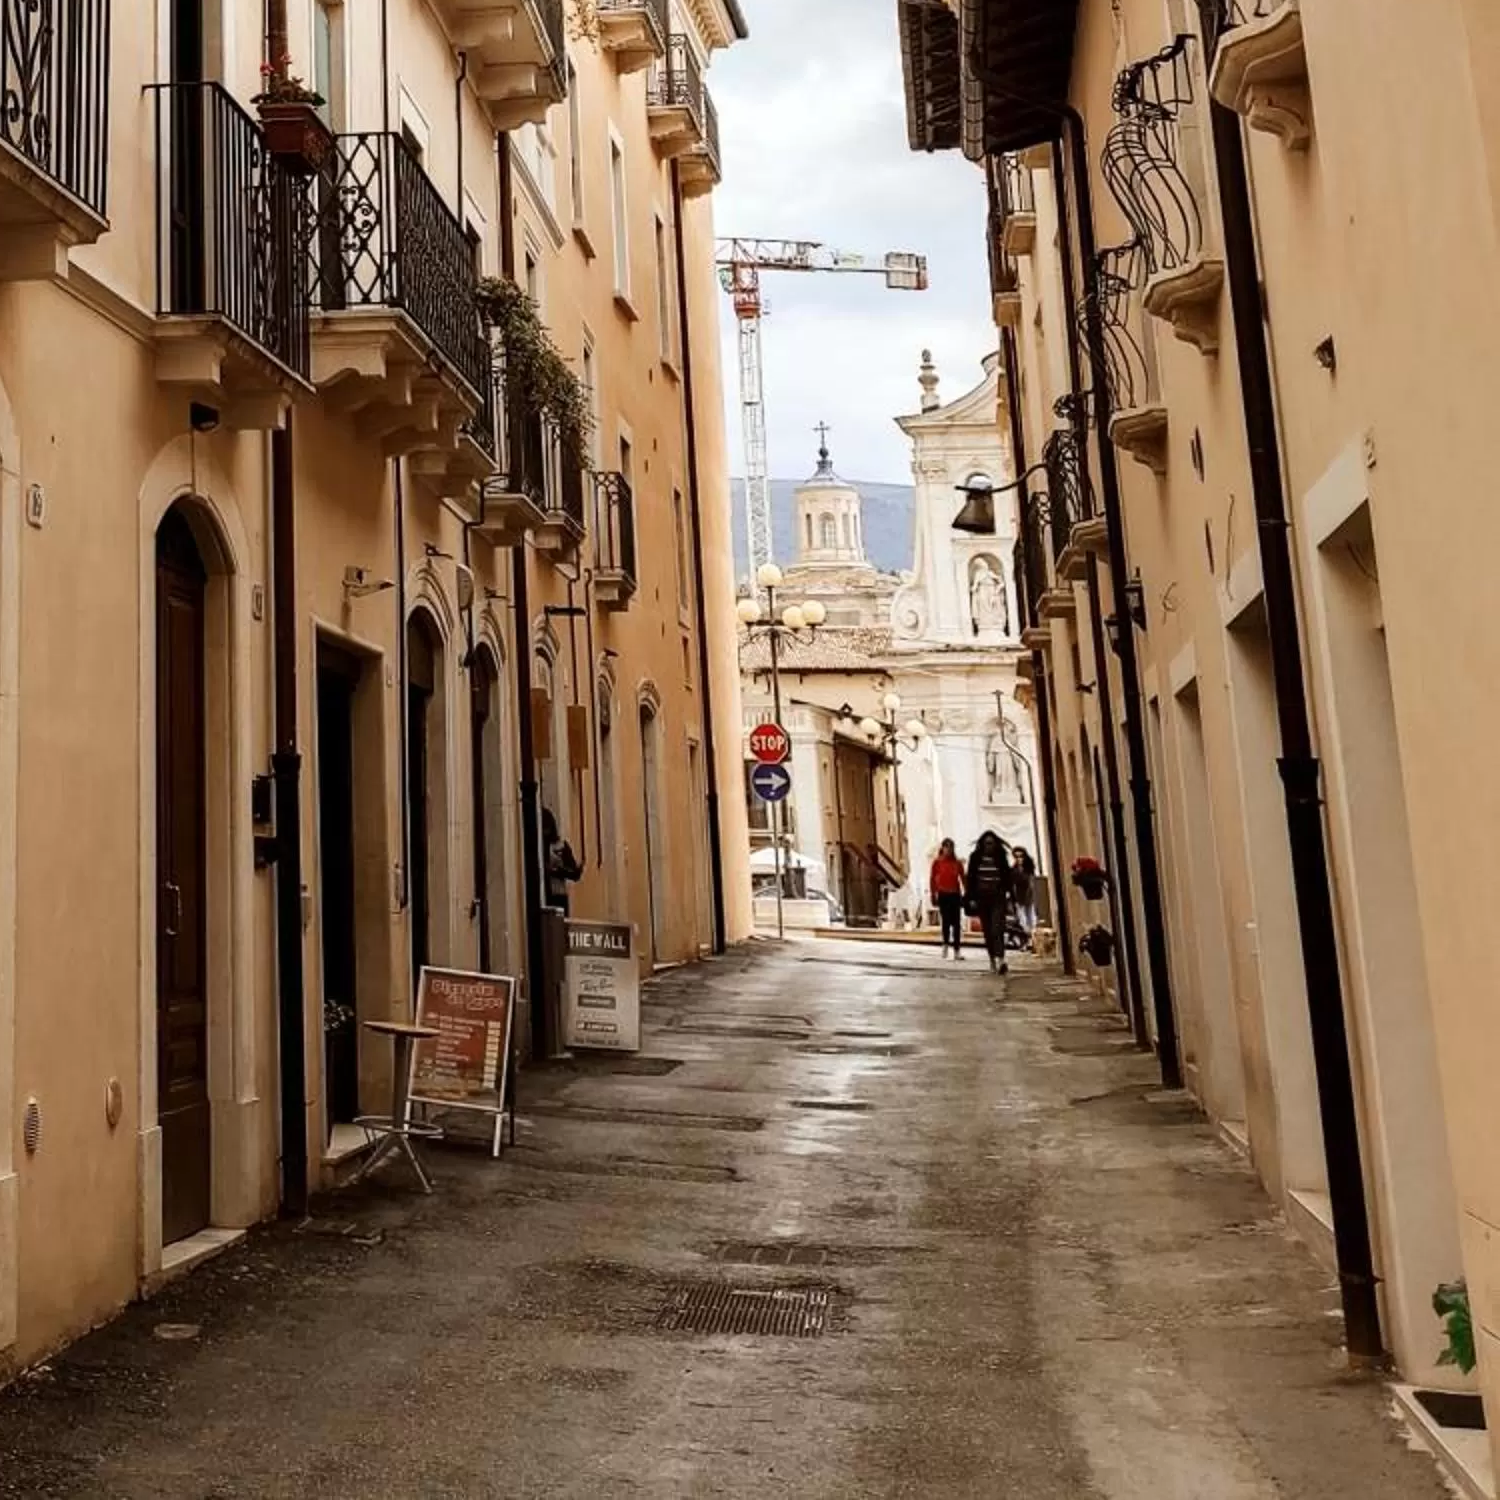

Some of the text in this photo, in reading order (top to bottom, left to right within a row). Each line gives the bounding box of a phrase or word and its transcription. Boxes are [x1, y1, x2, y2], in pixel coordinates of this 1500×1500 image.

[751, 735, 785, 751] STOP
[568, 931, 627, 950] THE WALL
